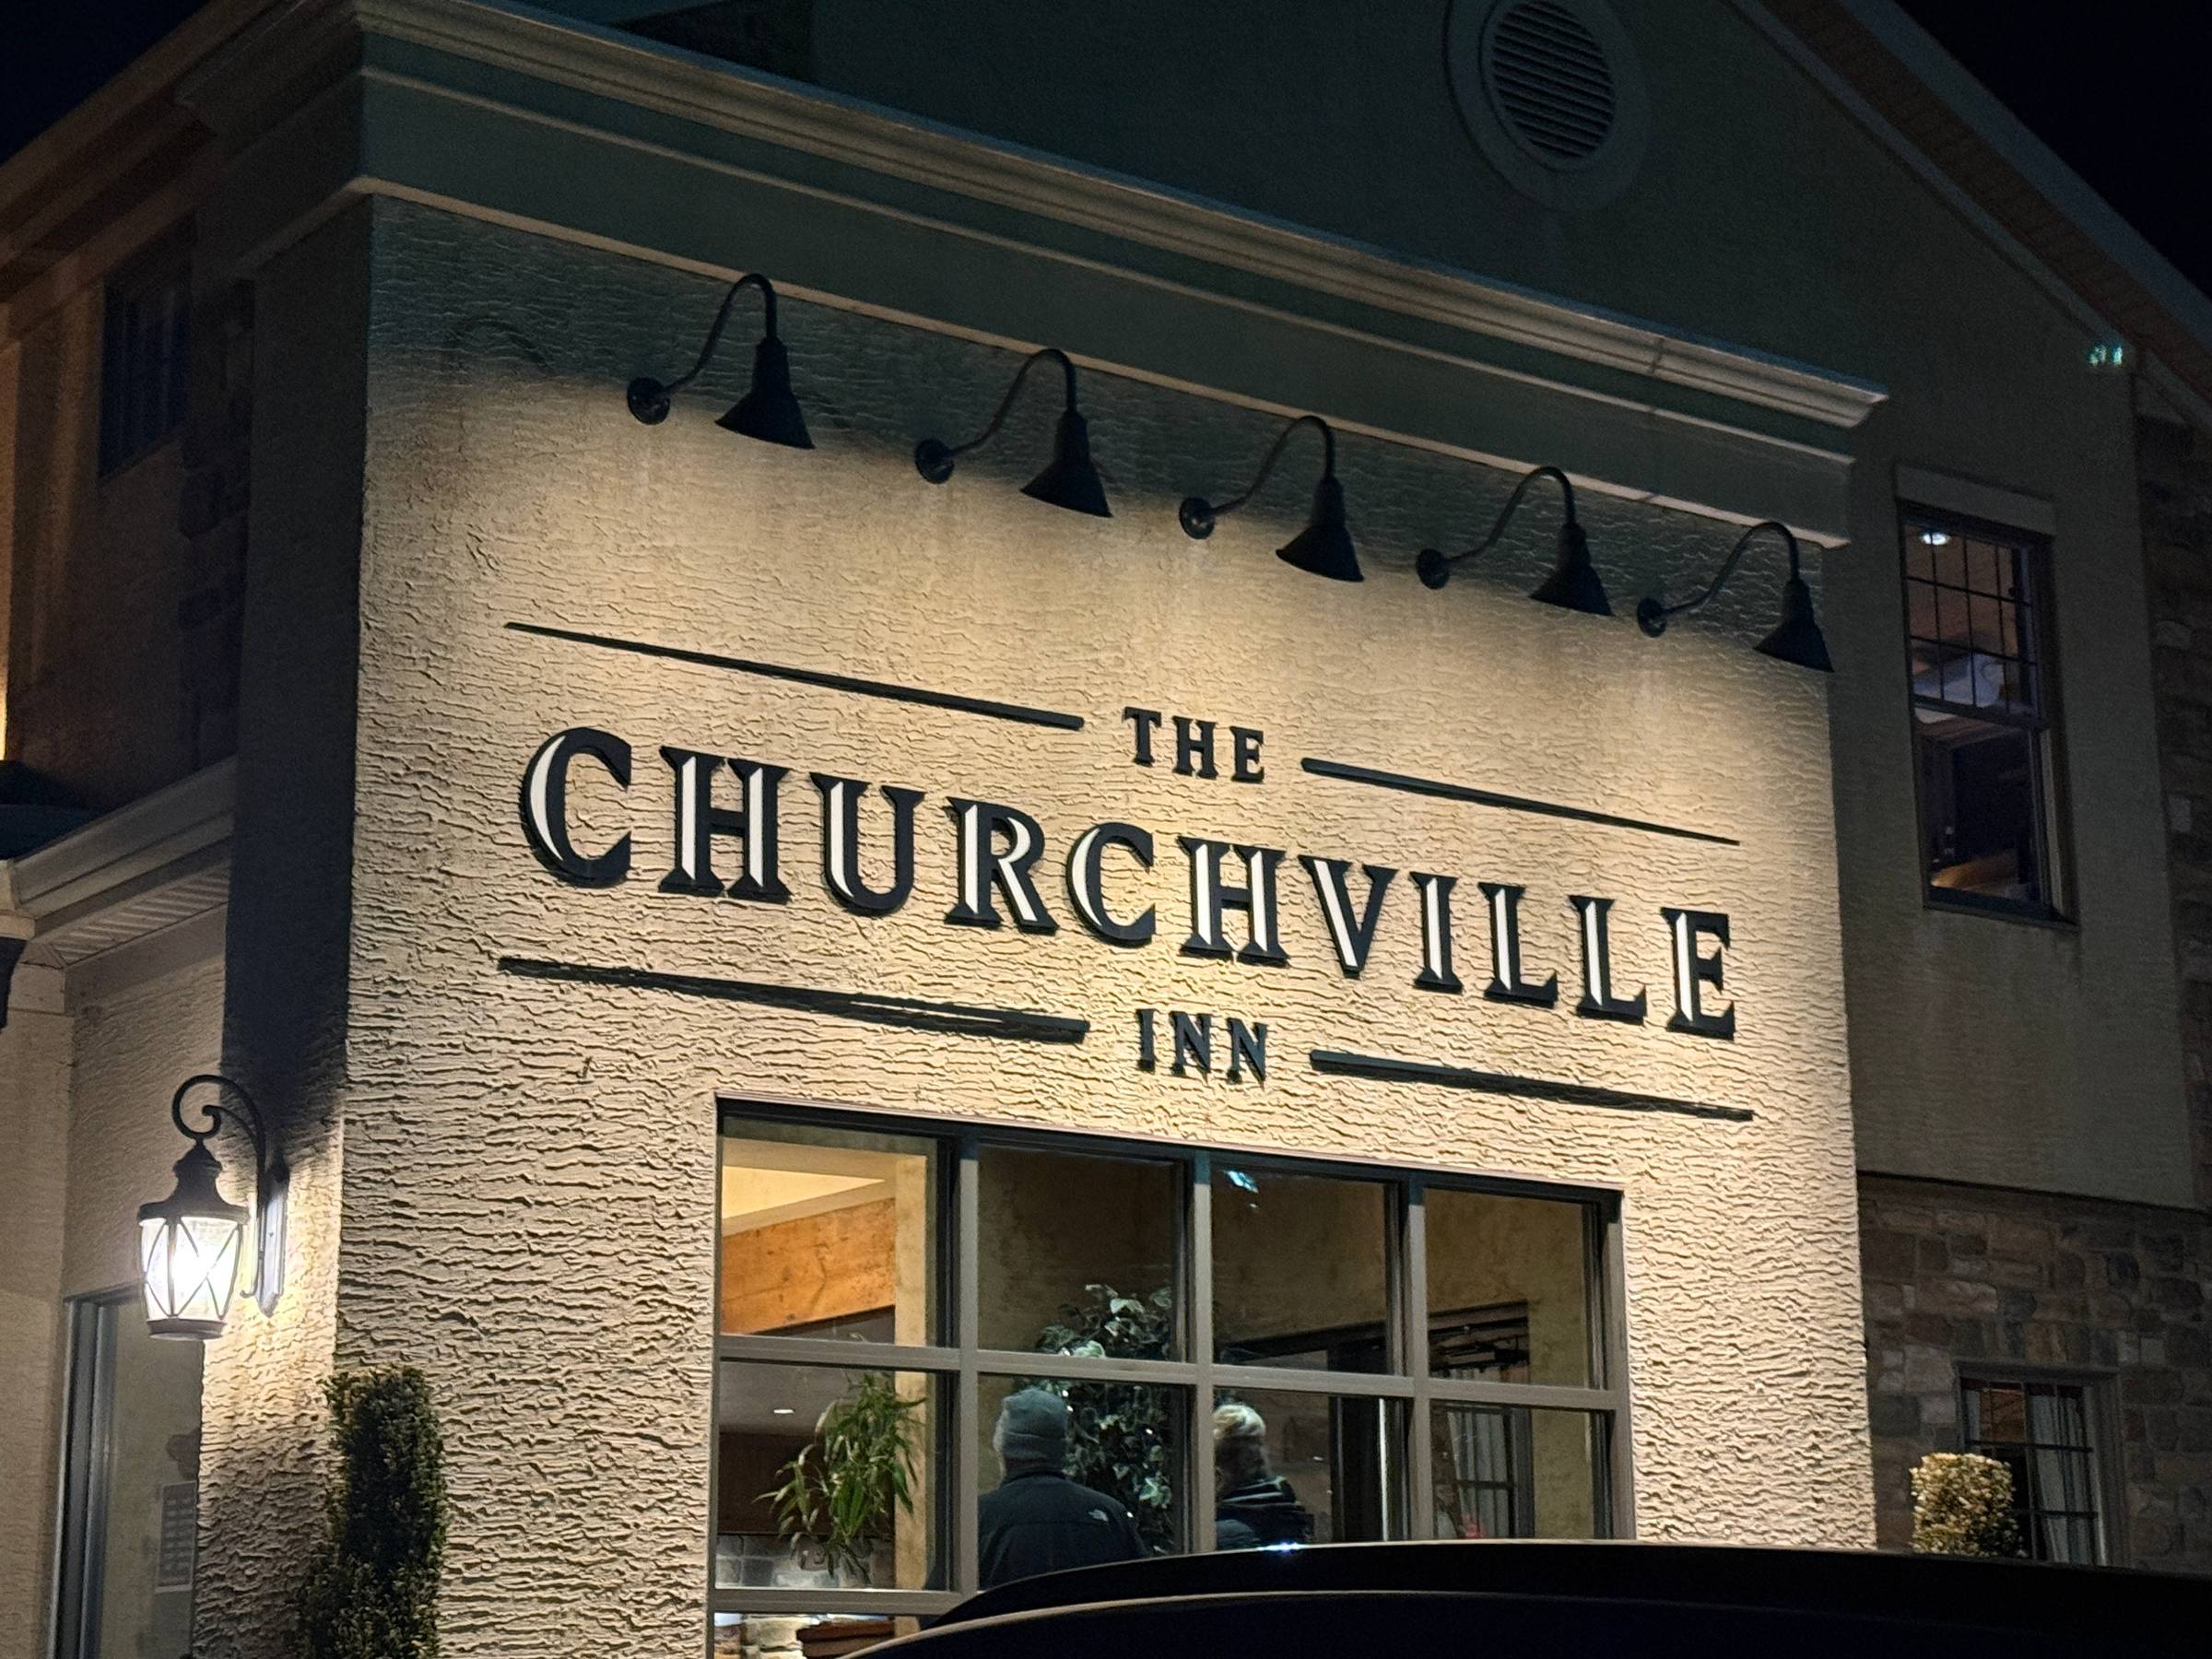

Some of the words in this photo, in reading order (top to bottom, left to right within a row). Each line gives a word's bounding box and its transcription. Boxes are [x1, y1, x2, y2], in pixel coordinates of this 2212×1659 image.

[1124, 707, 1265, 783] THE
[520, 726, 1735, 1041] CHURCHVILLE
[1135, 1007, 1269, 1088] INN
